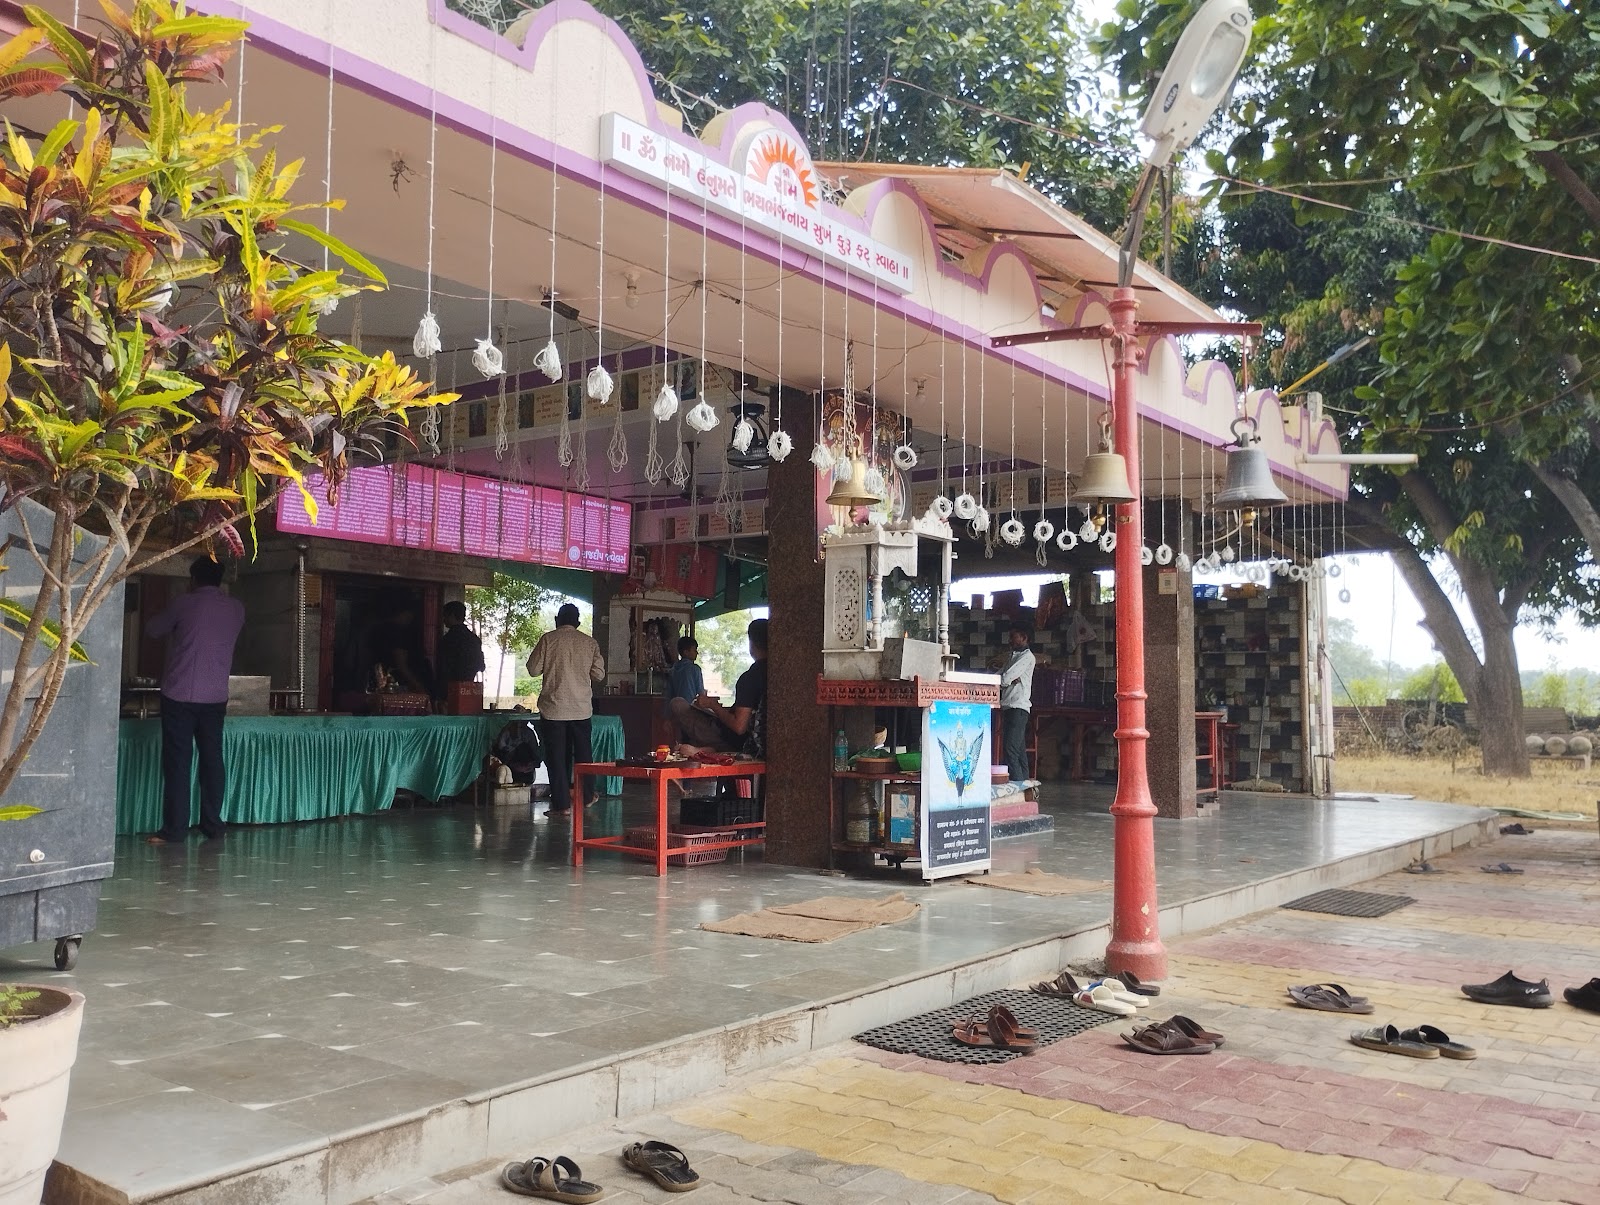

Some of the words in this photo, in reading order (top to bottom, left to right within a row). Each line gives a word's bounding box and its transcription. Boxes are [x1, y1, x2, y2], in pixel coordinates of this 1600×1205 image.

[782, 168, 790, 178] શ્રી
[773, 174, 797, 201] રામ
[662, 153, 691, 177] નમો
[696, 168, 737, 200] હનુમતે
[812, 221, 831, 244] સુખં
[875, 253, 898, 275] સ્વાહા
